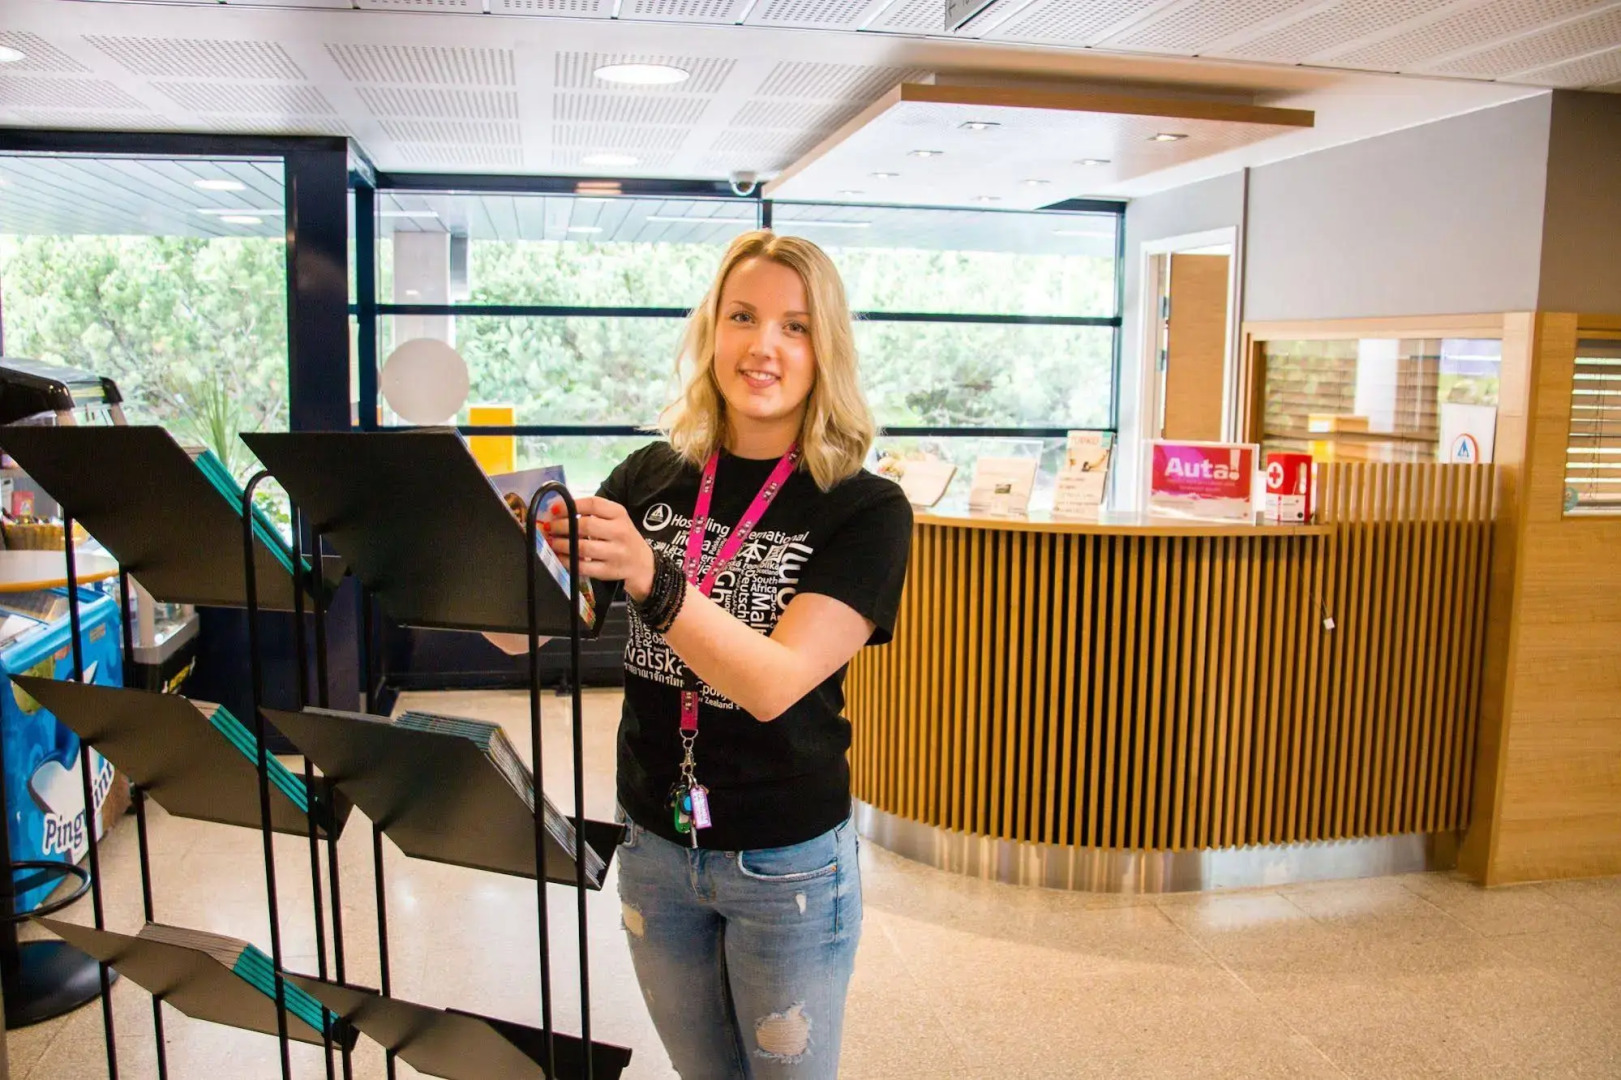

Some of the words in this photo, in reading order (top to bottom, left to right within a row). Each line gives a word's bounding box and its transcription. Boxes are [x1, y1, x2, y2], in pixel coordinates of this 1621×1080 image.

[1165, 448, 1240, 480] Auta!
[671, 513, 730, 538] Hosling
[749, 530, 810, 545] ernational
[750, 583, 778, 594] Africa
[751, 573, 779, 584] South
[737, 569, 756, 622] Deutschl
[704, 696, 734, 710] Zealand
